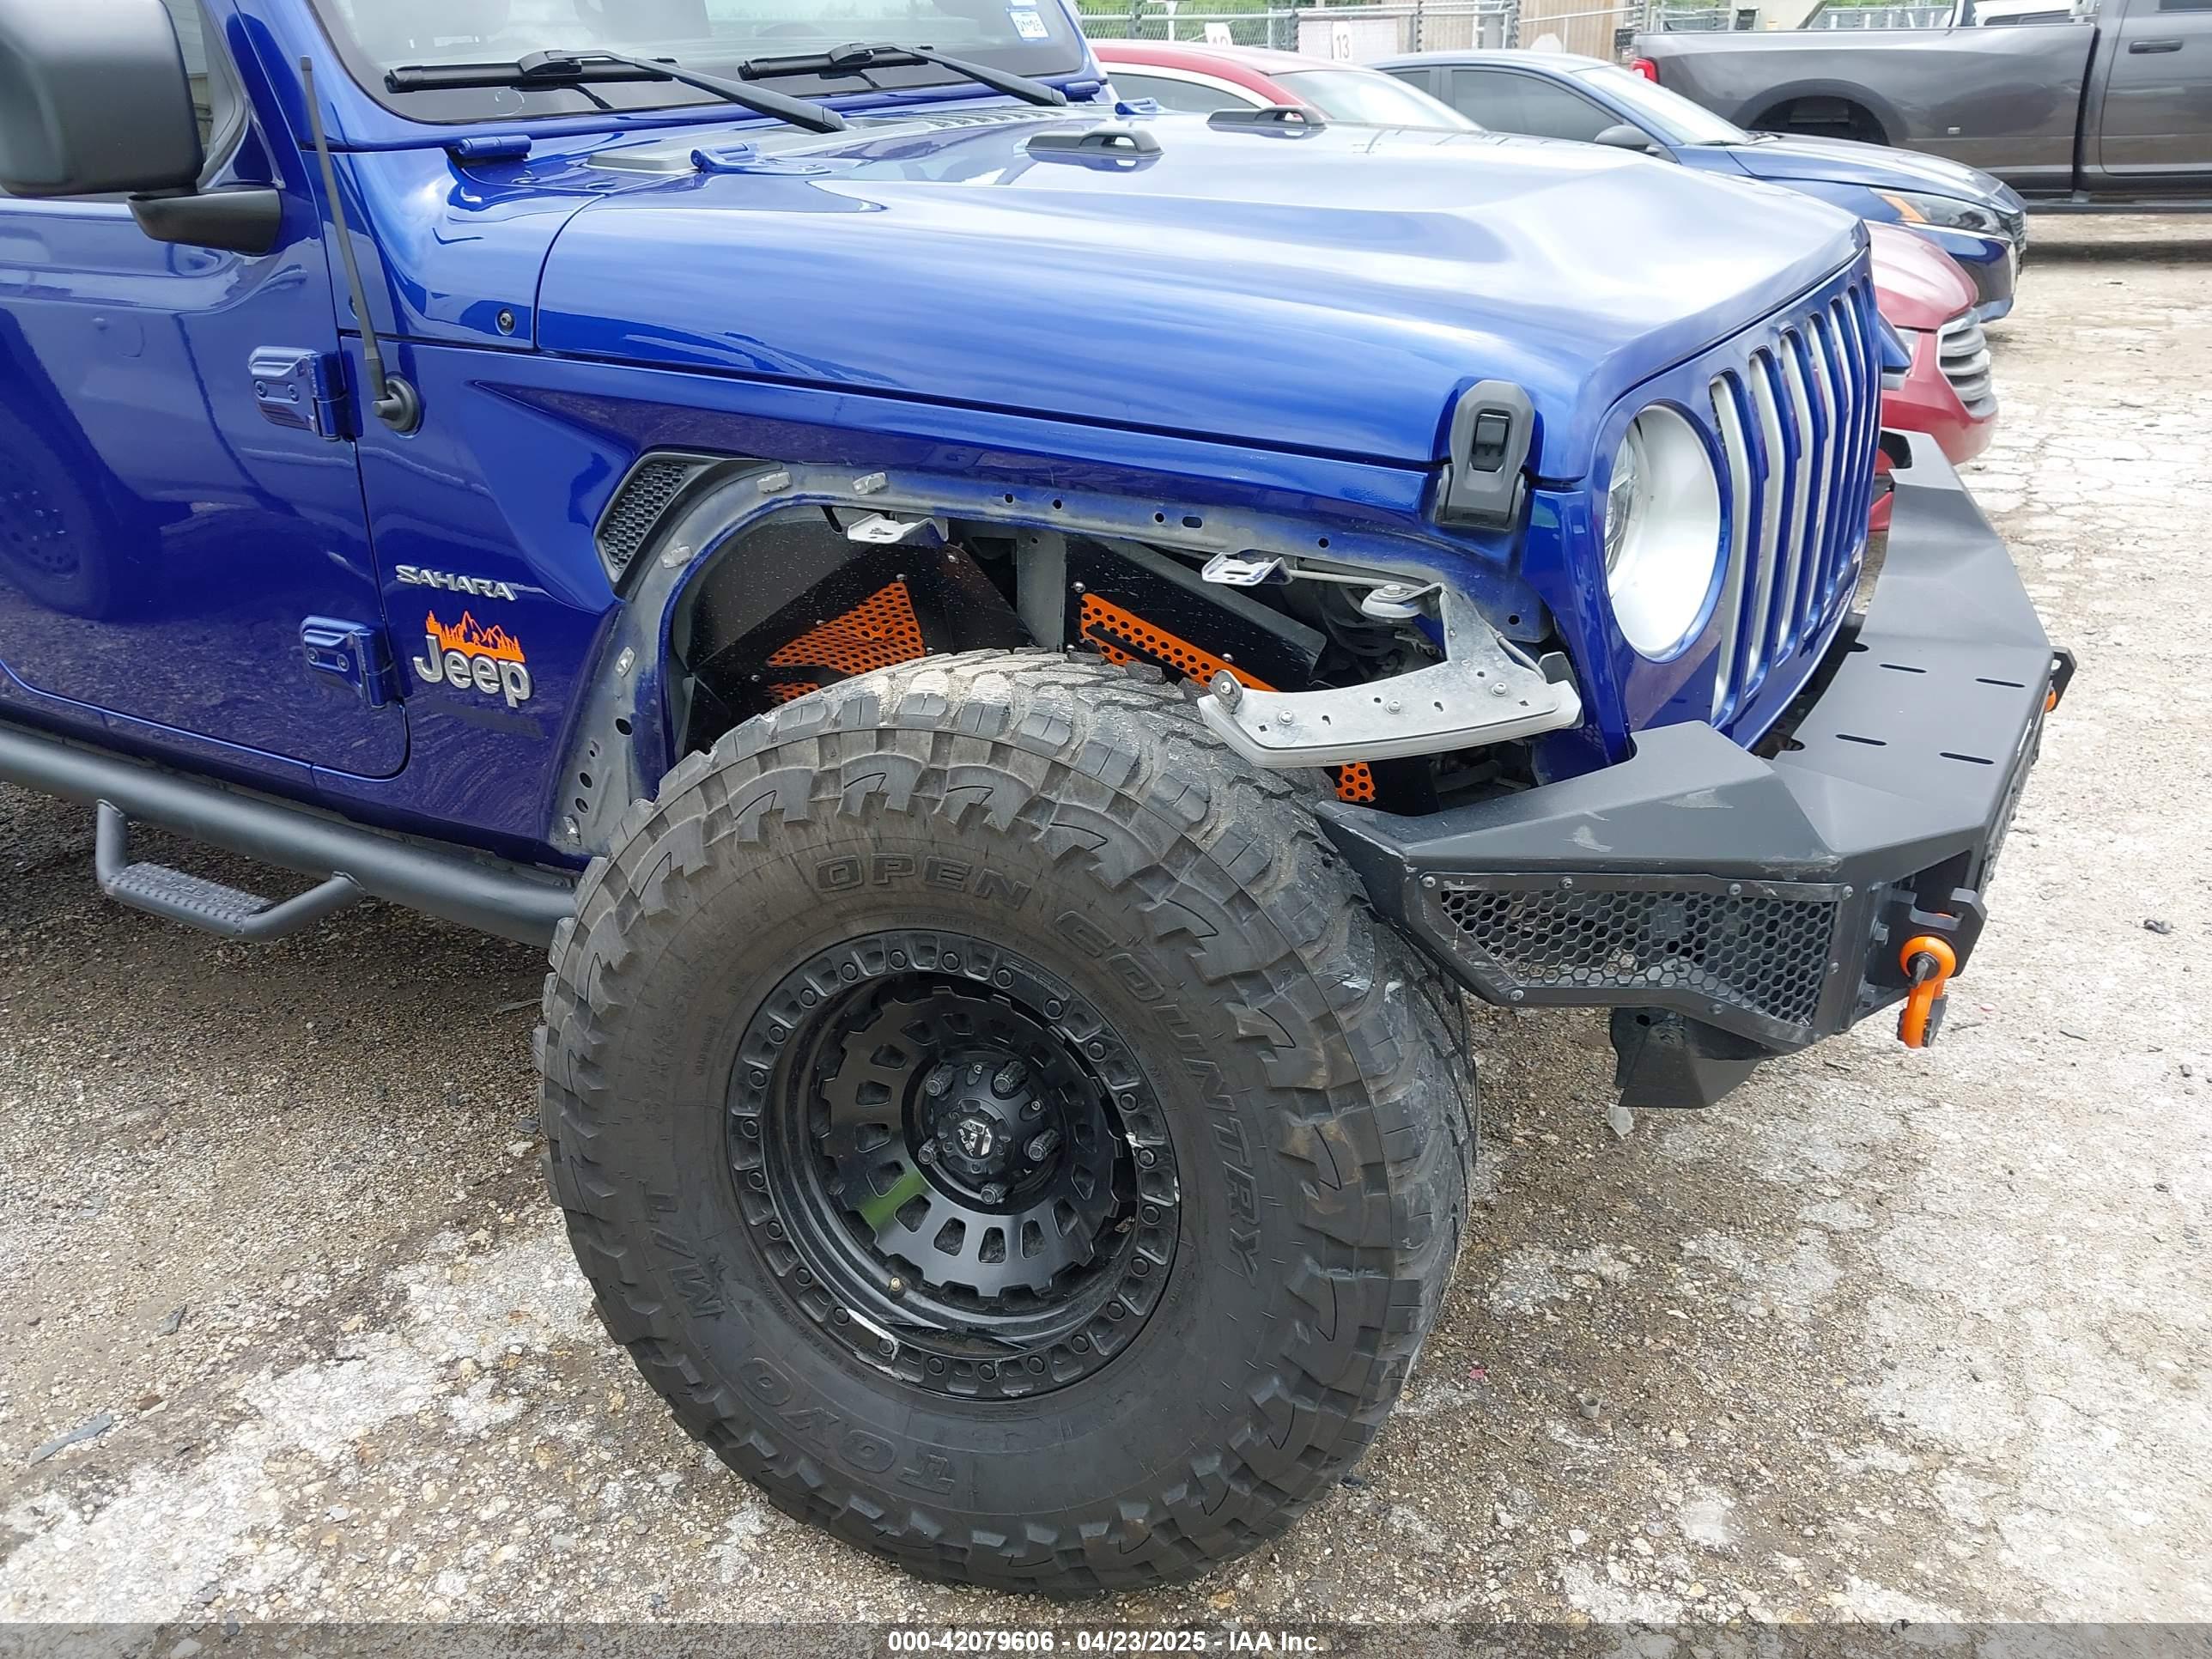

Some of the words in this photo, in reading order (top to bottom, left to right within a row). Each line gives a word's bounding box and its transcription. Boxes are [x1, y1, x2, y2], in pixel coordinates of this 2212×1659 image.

[1336, 33, 1350, 59] 13
[395, 565, 516, 601] SAHARA
[413, 635, 533, 708] Jeep
[815, 853, 1030, 910] OPEN
[1054, 910, 1262, 1277] COUNTRY
[957, 1128, 974, 1157] FUEL
[741, 1357, 955, 1495] TOYO
